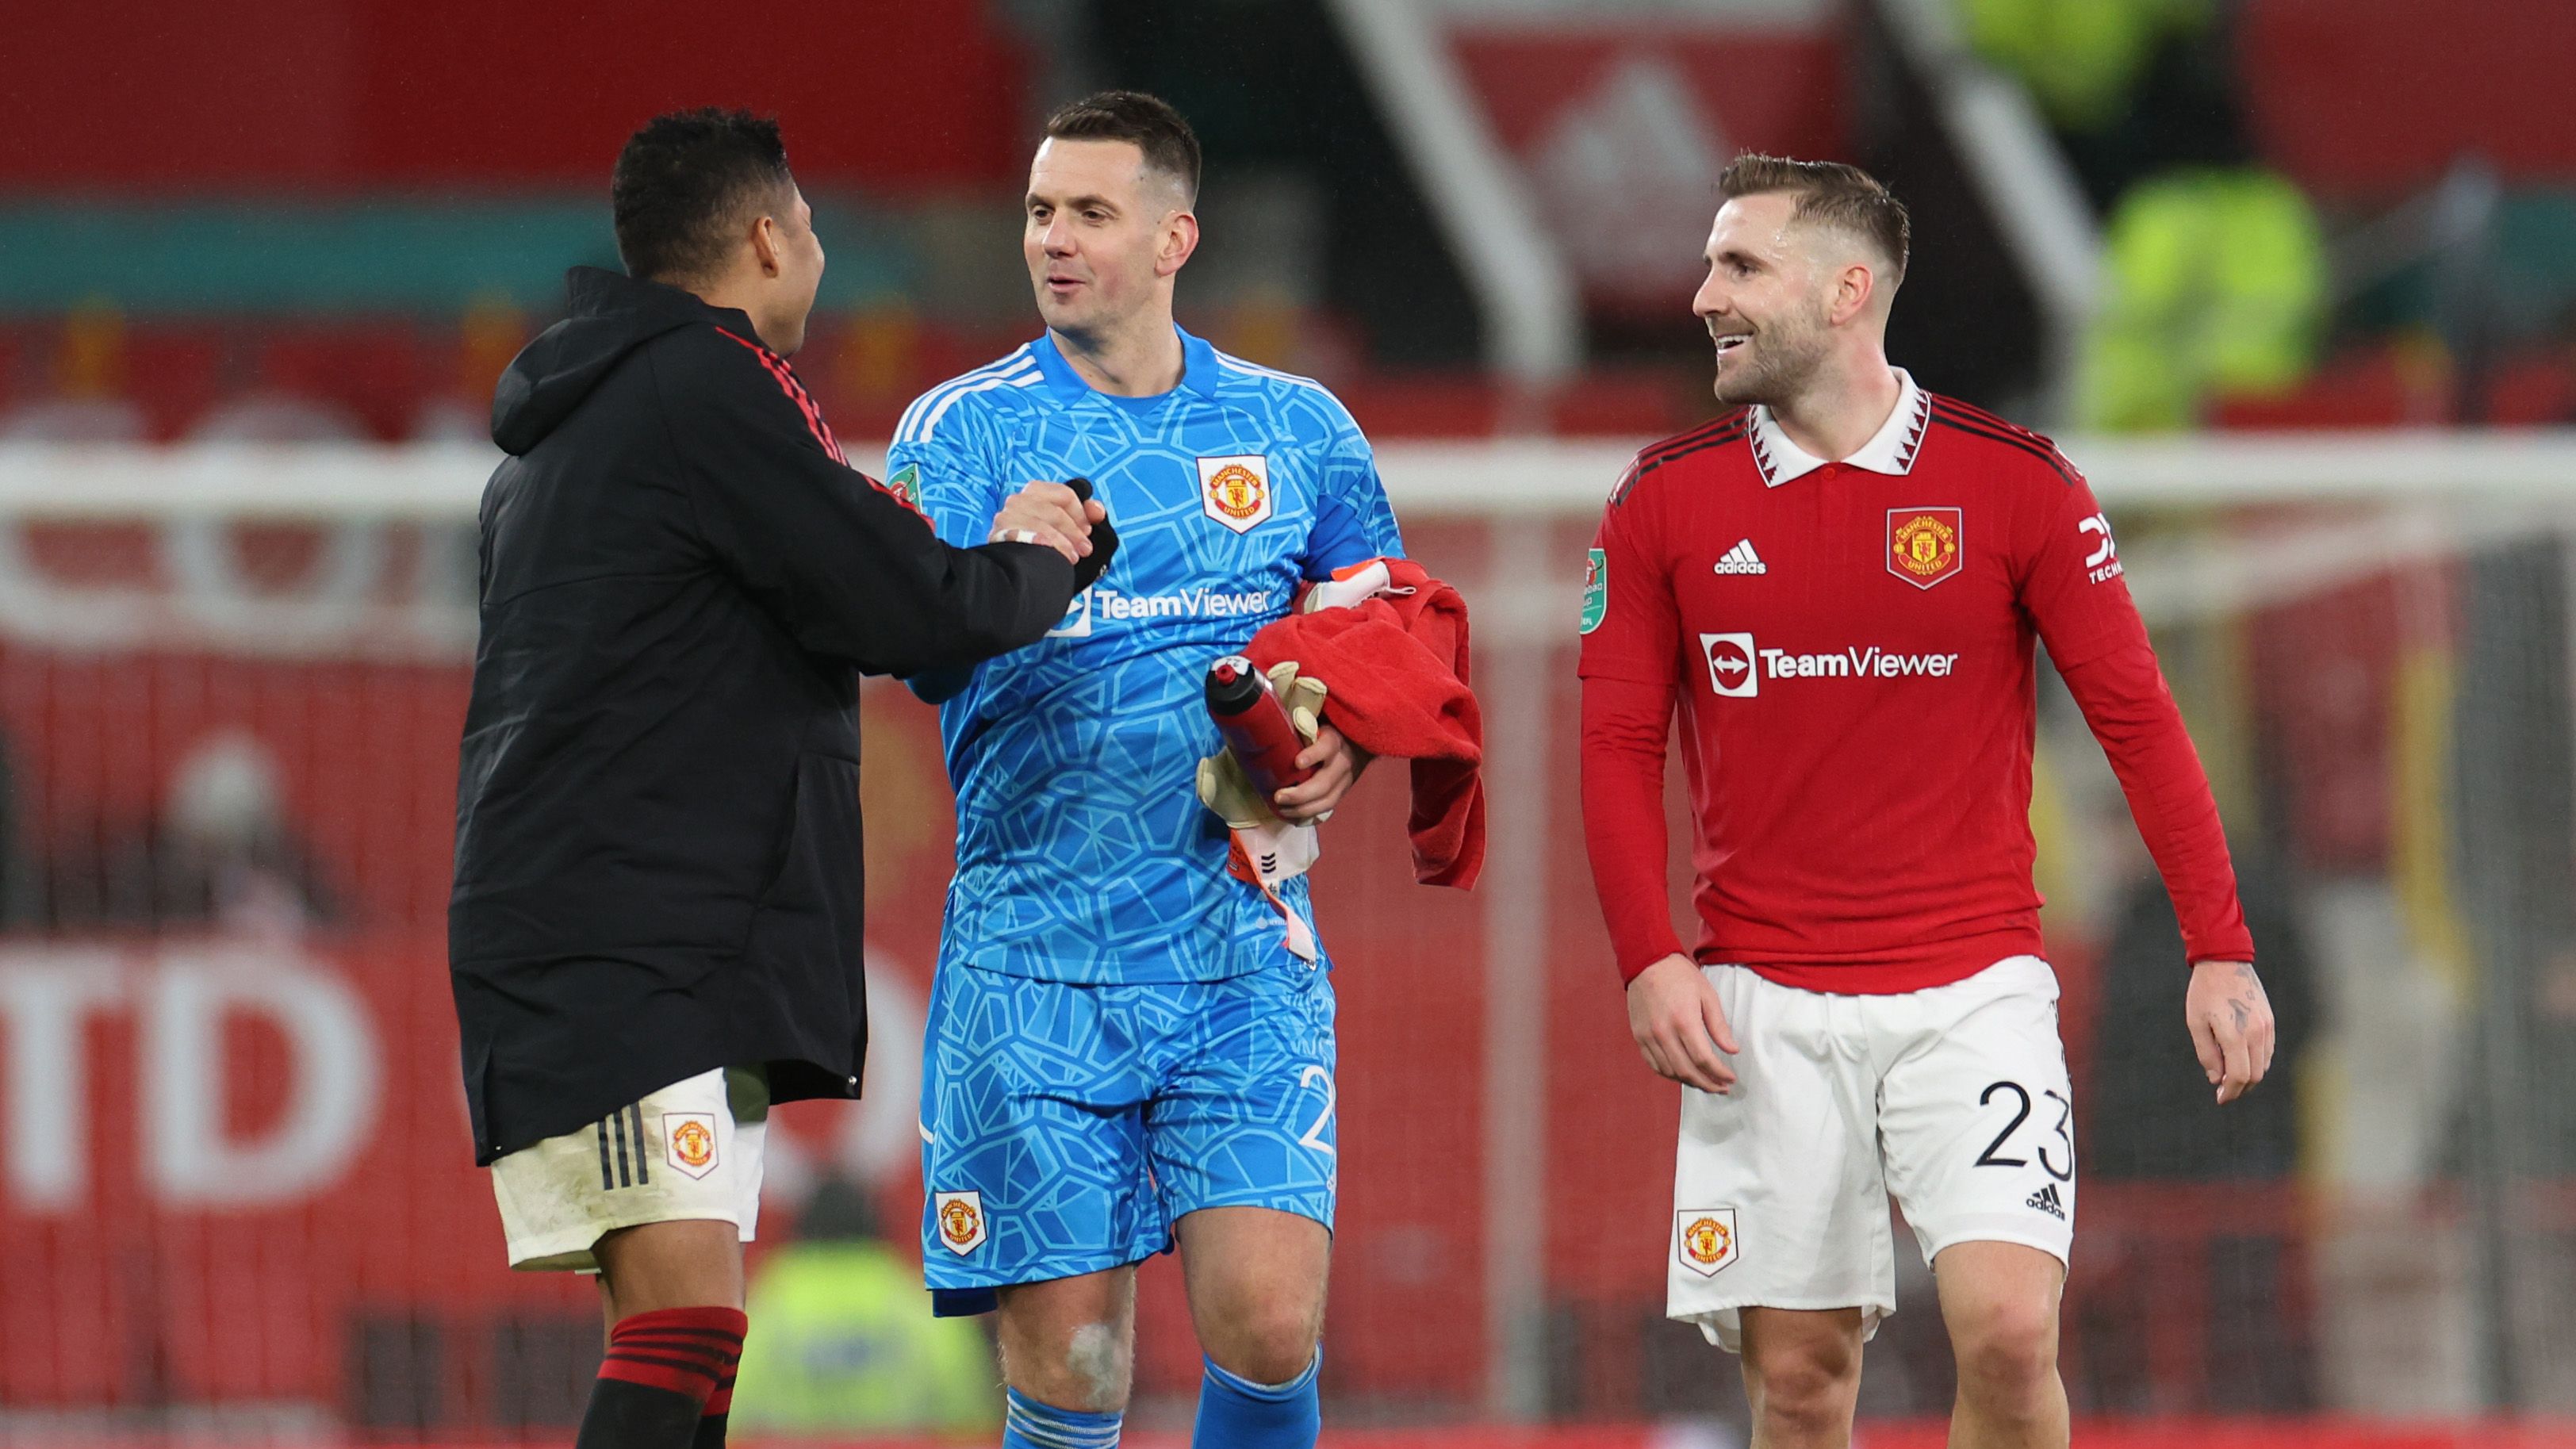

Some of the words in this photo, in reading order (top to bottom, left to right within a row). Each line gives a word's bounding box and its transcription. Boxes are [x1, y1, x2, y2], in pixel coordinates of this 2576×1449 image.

[1213, 468, 1259, 486] MANCHESTER
[1224, 506, 1255, 516] UNITED
[1901, 520, 1949, 539] MANCHESTER
[1714, 561, 1767, 574] adidas
[1908, 560, 1942, 571] UNITED
[2089, 561, 2123, 584] TECHN
[1094, 588, 1271, 619] TeamViewer
[1759, 646, 1957, 678] TeamViewer
[1972, 1081, 2072, 1182] 23
[942, 1202, 973, 1217] MANCHESTER
[1688, 1220, 1727, 1236] MANCHESTER
[949, 1233, 972, 1242] UNITED
[1695, 1252, 1722, 1263] UNITED
